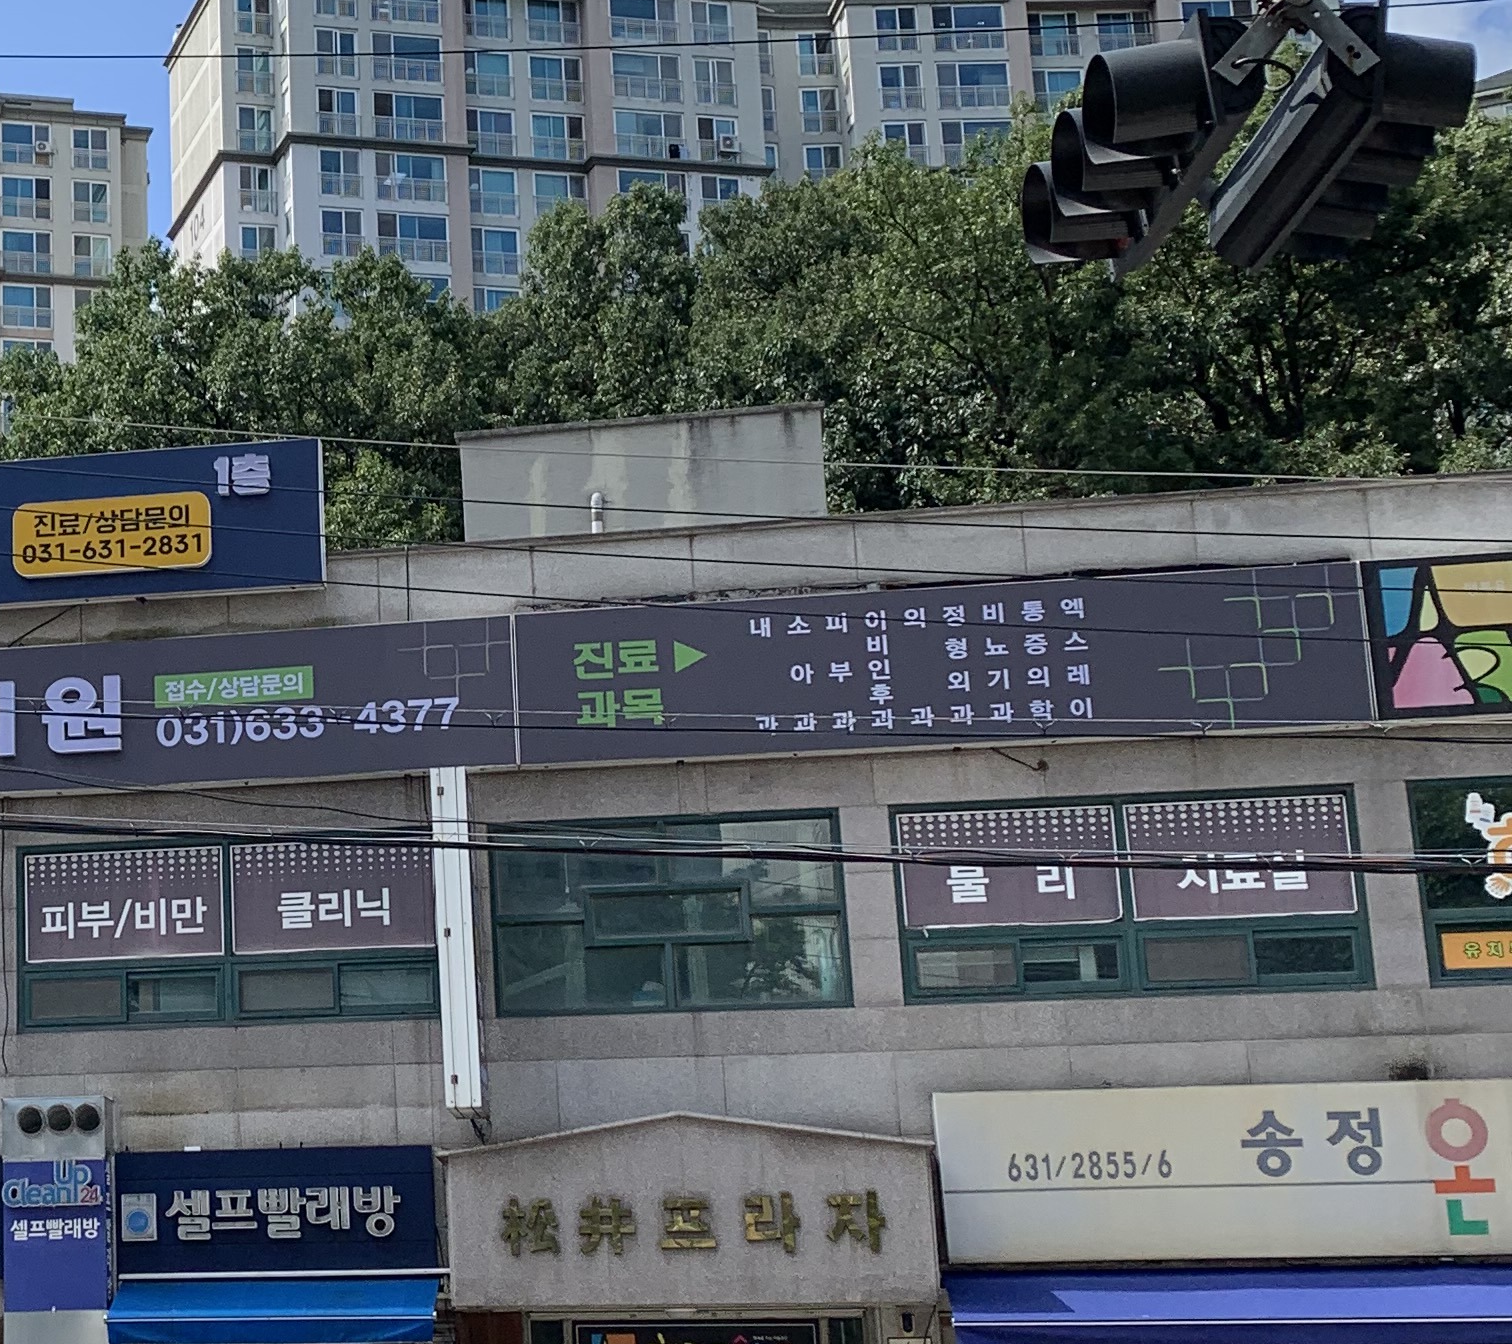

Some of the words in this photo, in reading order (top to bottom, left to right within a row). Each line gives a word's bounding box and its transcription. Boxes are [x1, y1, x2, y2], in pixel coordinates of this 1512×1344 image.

[213, 453, 271, 497] 1층
[33, 503, 190, 538] 진료/상담문의
[22, 533, 203, 564] 031-631-2831
[573, 639, 659, 682] 진료
[164, 670, 304, 702] 접수/상담문의
[577, 687, 664, 729] 과목
[40, 896, 207, 942] 피부/비만
[276, 887, 392, 928] 클리닉
[1007, 1149, 1172, 1183] 631/2855/6
[10, 1217, 101, 1242] 셀프빨래방
[165, 1185, 401, 1241] 셀프빨래방
